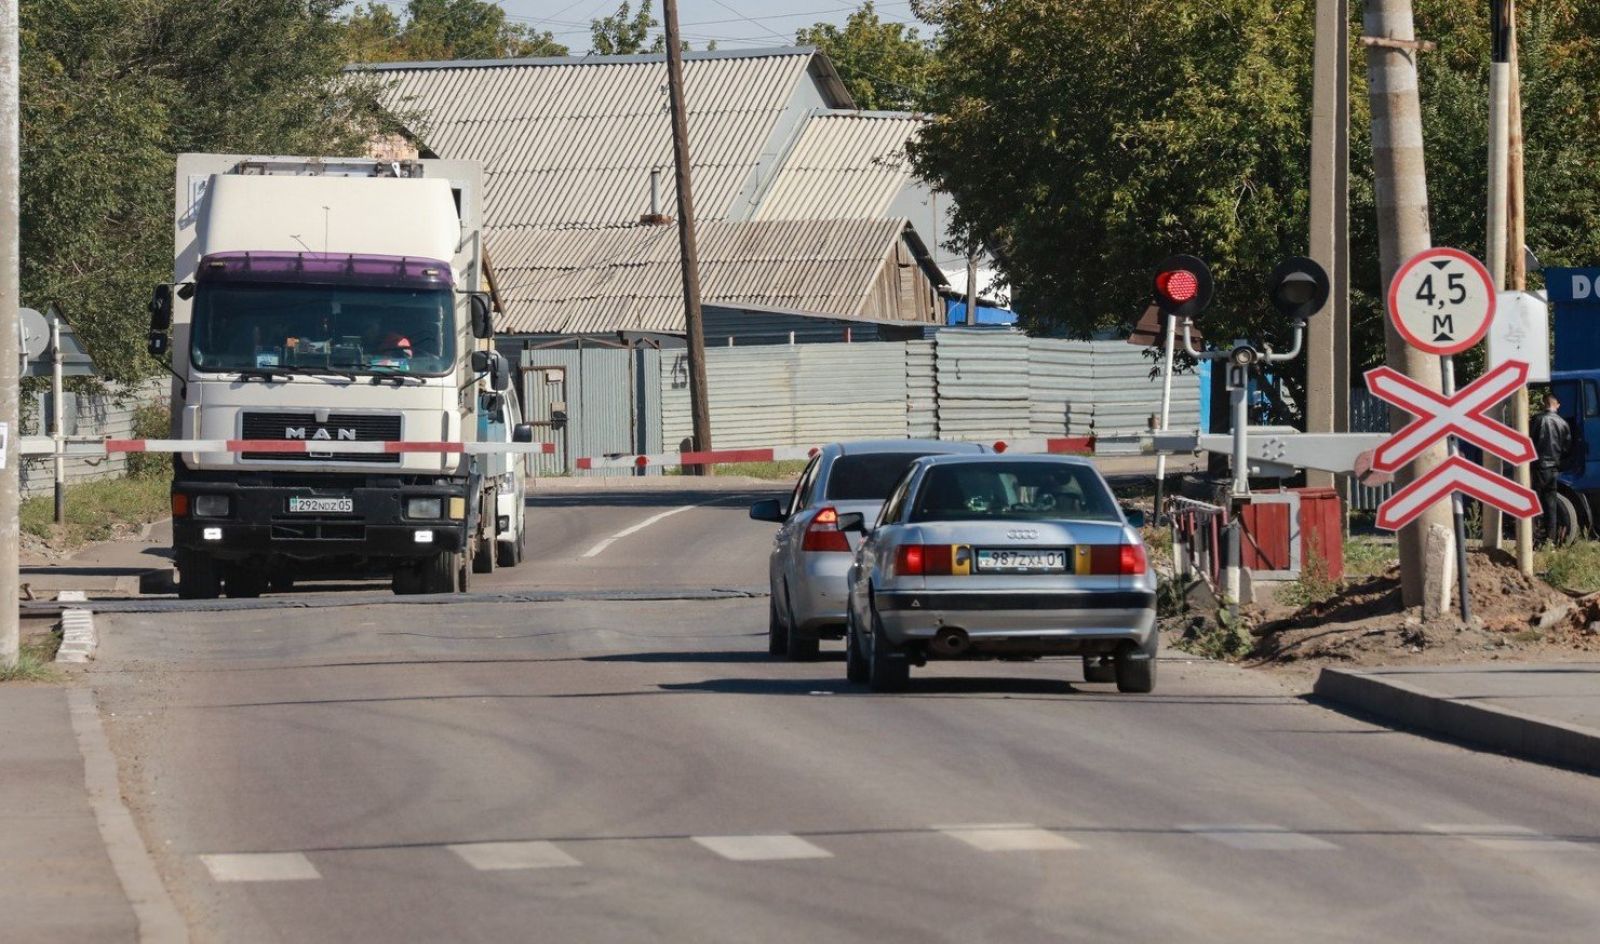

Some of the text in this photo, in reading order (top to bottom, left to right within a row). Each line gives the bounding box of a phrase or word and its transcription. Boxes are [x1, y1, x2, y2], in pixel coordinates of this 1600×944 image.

[1416, 273, 1467, 310] 4,5
[285, 427, 356, 440] MAN
[299, 500, 337, 511] 292NDZ
[338, 500, 351, 511] 05
[1047, 552, 1065, 566] 01
